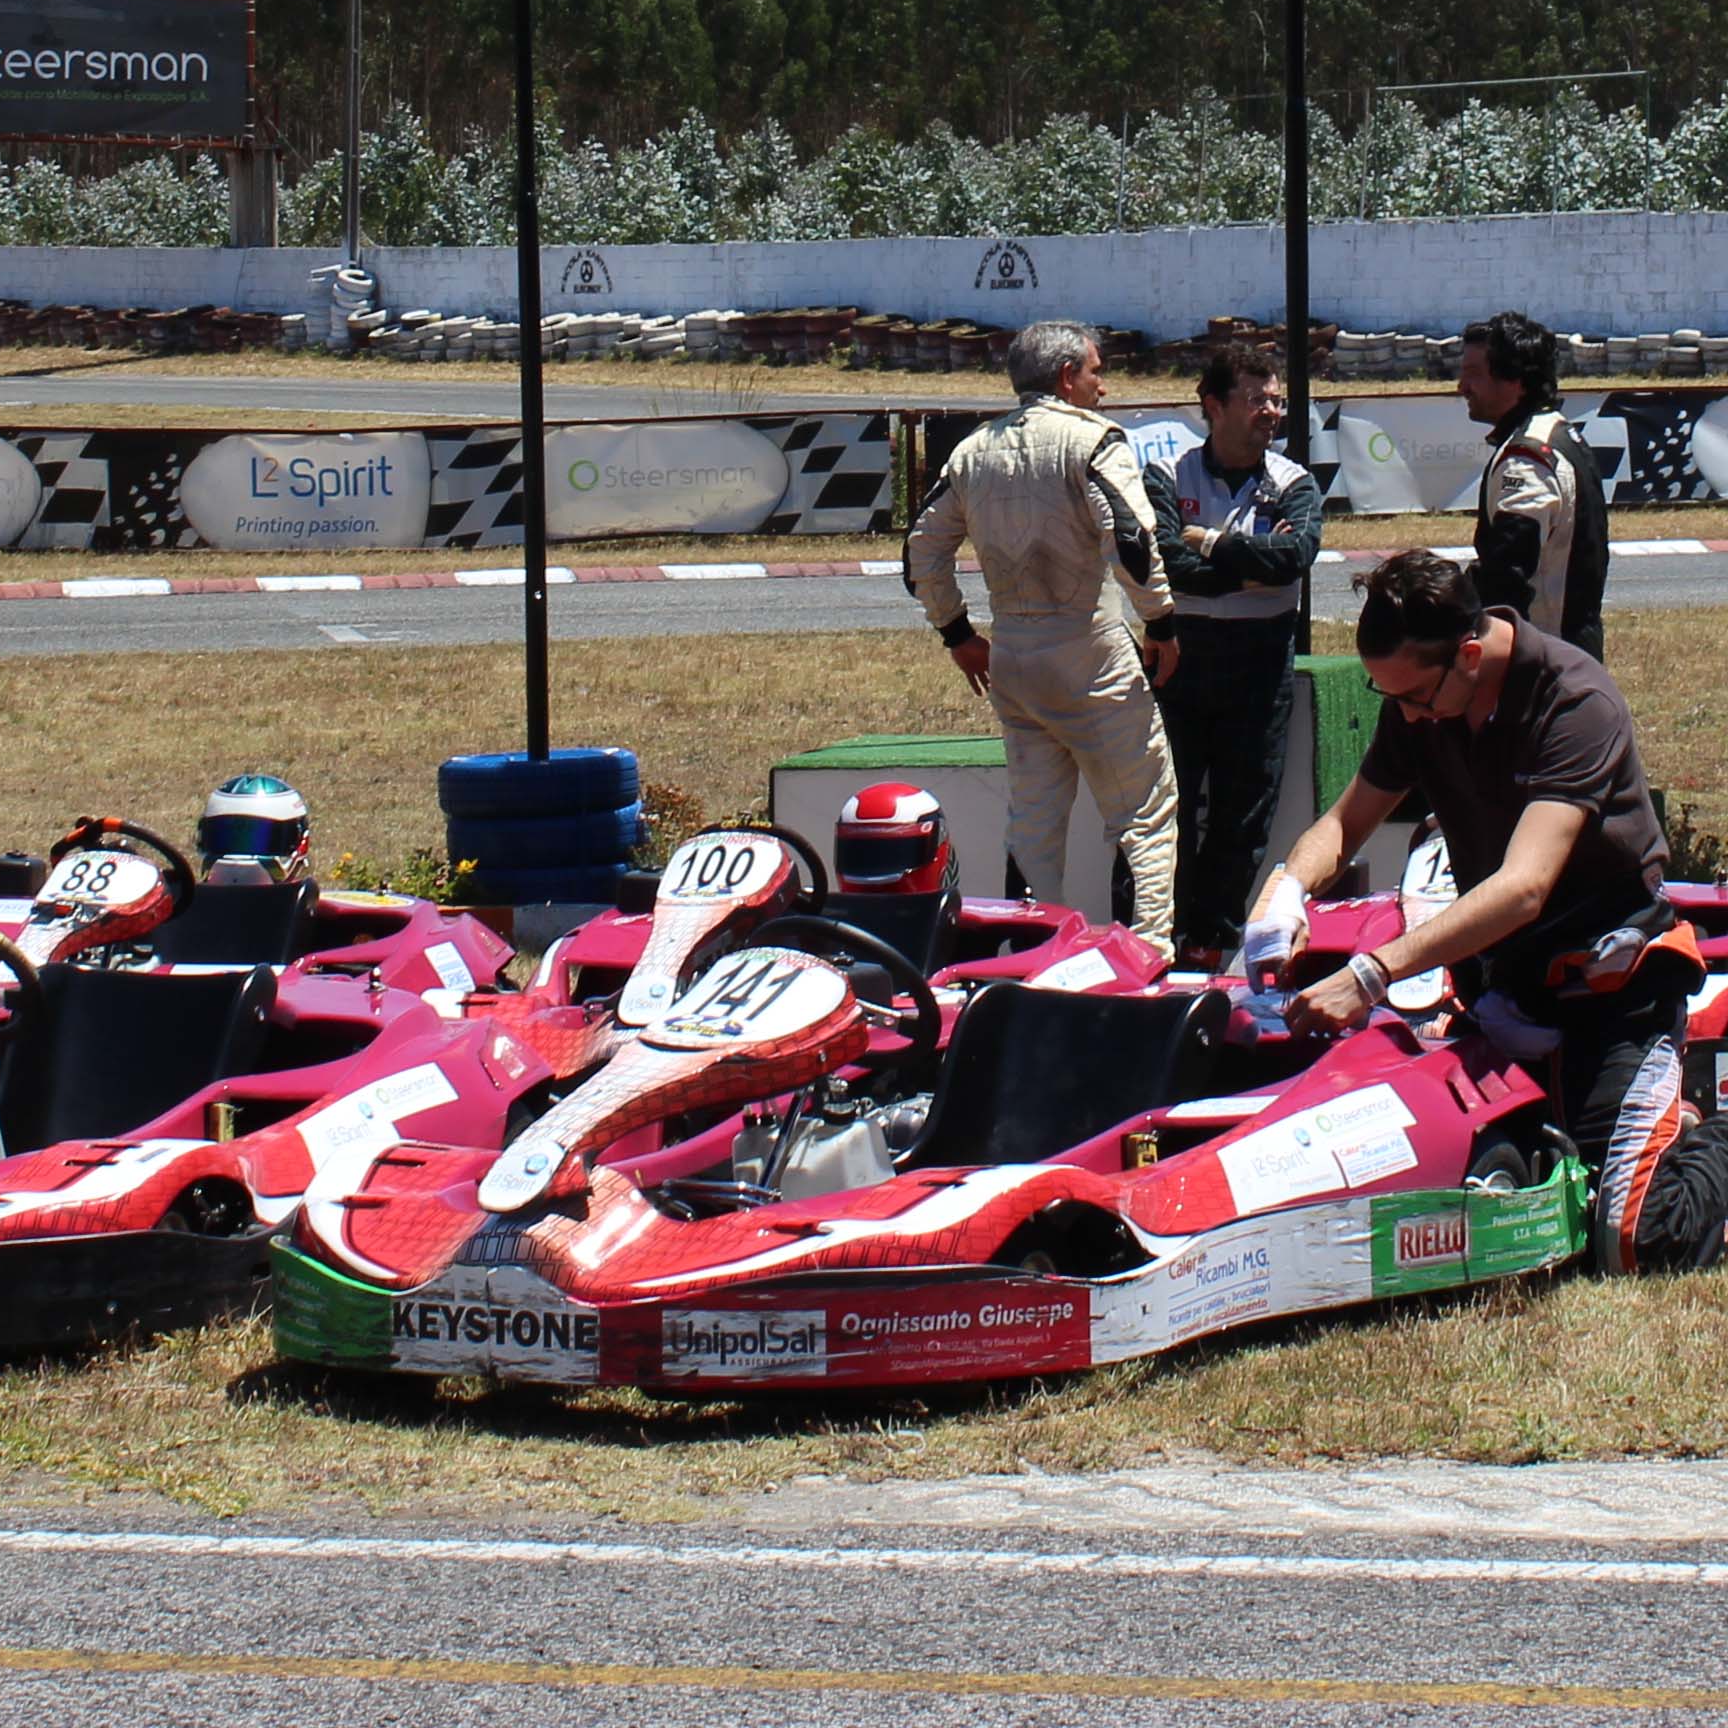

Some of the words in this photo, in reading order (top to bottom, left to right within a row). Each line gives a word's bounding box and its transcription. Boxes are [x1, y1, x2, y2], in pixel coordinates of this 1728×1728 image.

[289, 455, 393, 507] Spirit
[604, 462, 756, 489] Steersman
[235, 515, 305, 540] Printing
[307, 516, 380, 540] passion.
[61, 860, 117, 893] 88
[678, 844, 755, 889] 100
[692, 959, 805, 1021] 141
[1399, 1220, 1466, 1263] RIELLO
[1196, 1254, 1239, 1289] Ricambi
[391, 1302, 599, 1352] KEYSTONE
[840, 1308, 971, 1340] Ognissanto
[978, 1301, 1074, 1329] Giuseppe
